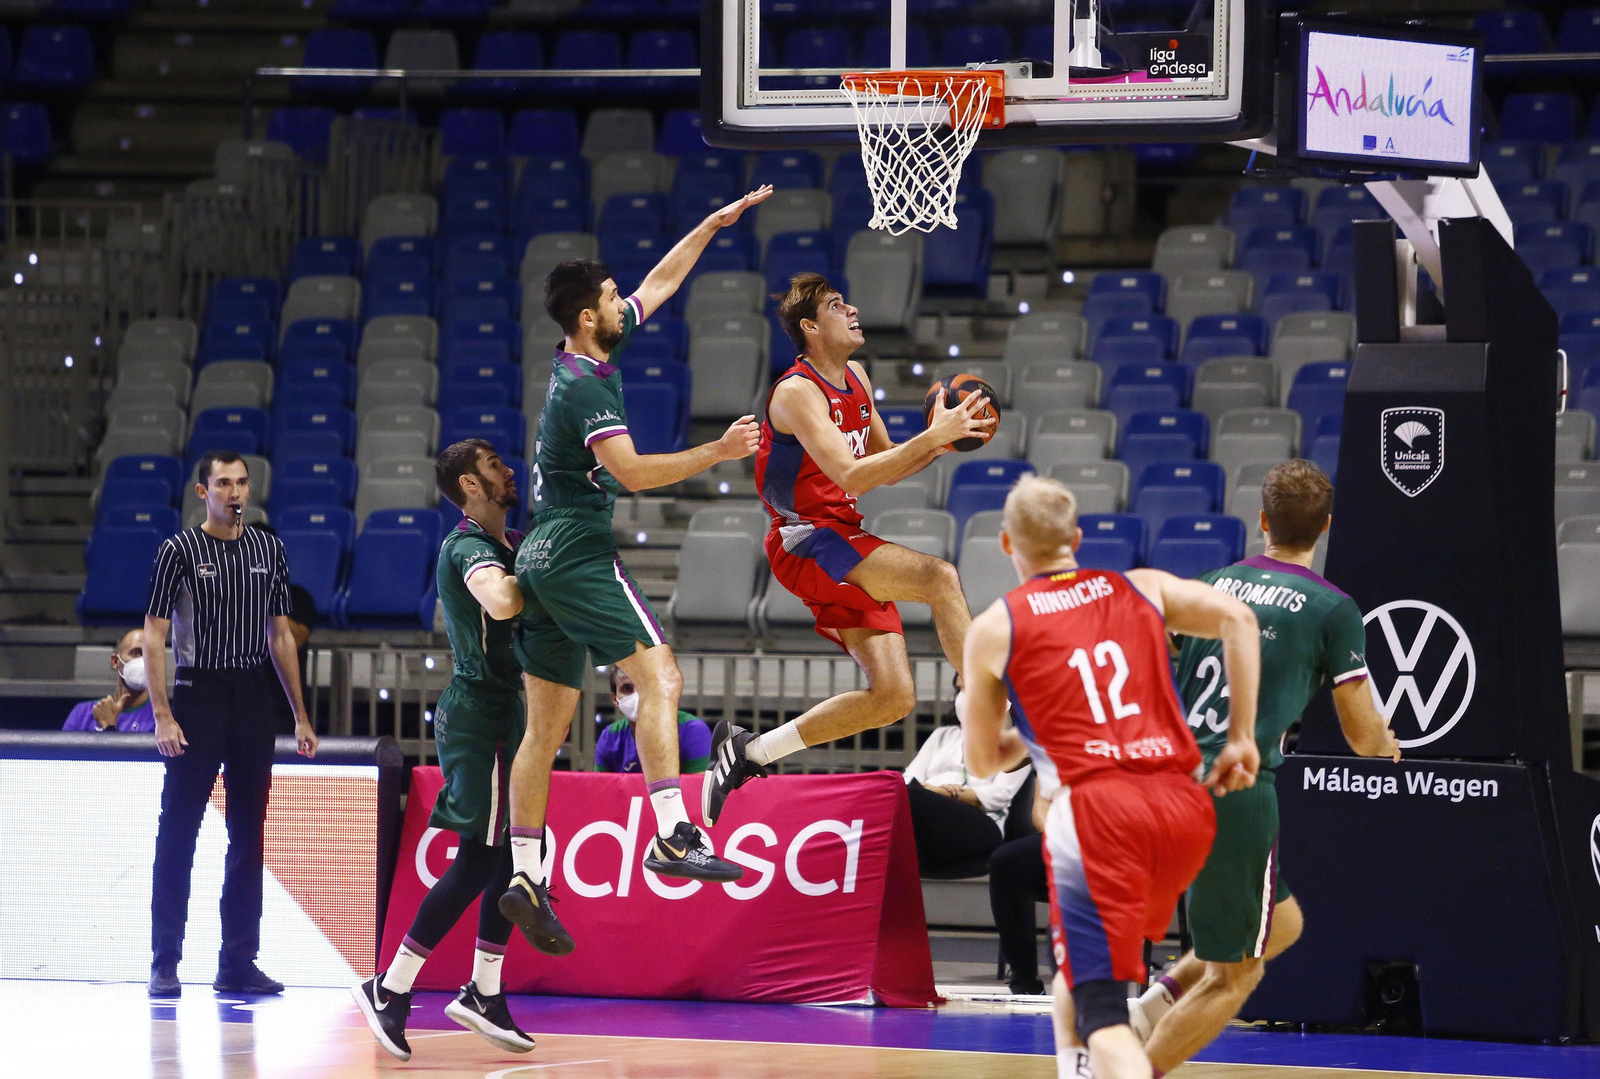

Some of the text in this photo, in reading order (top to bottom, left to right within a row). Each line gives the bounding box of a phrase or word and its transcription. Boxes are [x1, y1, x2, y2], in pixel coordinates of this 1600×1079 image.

[1150, 47, 1175, 63] liga
[1150, 61, 1206, 75] endesa
[1308, 65, 1454, 126] Andalucía
[1394, 450, 1430, 462] Unicaja
[1026, 575, 1114, 616] HINRICHS
[1067, 639, 1141, 725] 12
[1303, 766, 1499, 803] Málaga Wagen
[415, 796, 864, 901] desa
